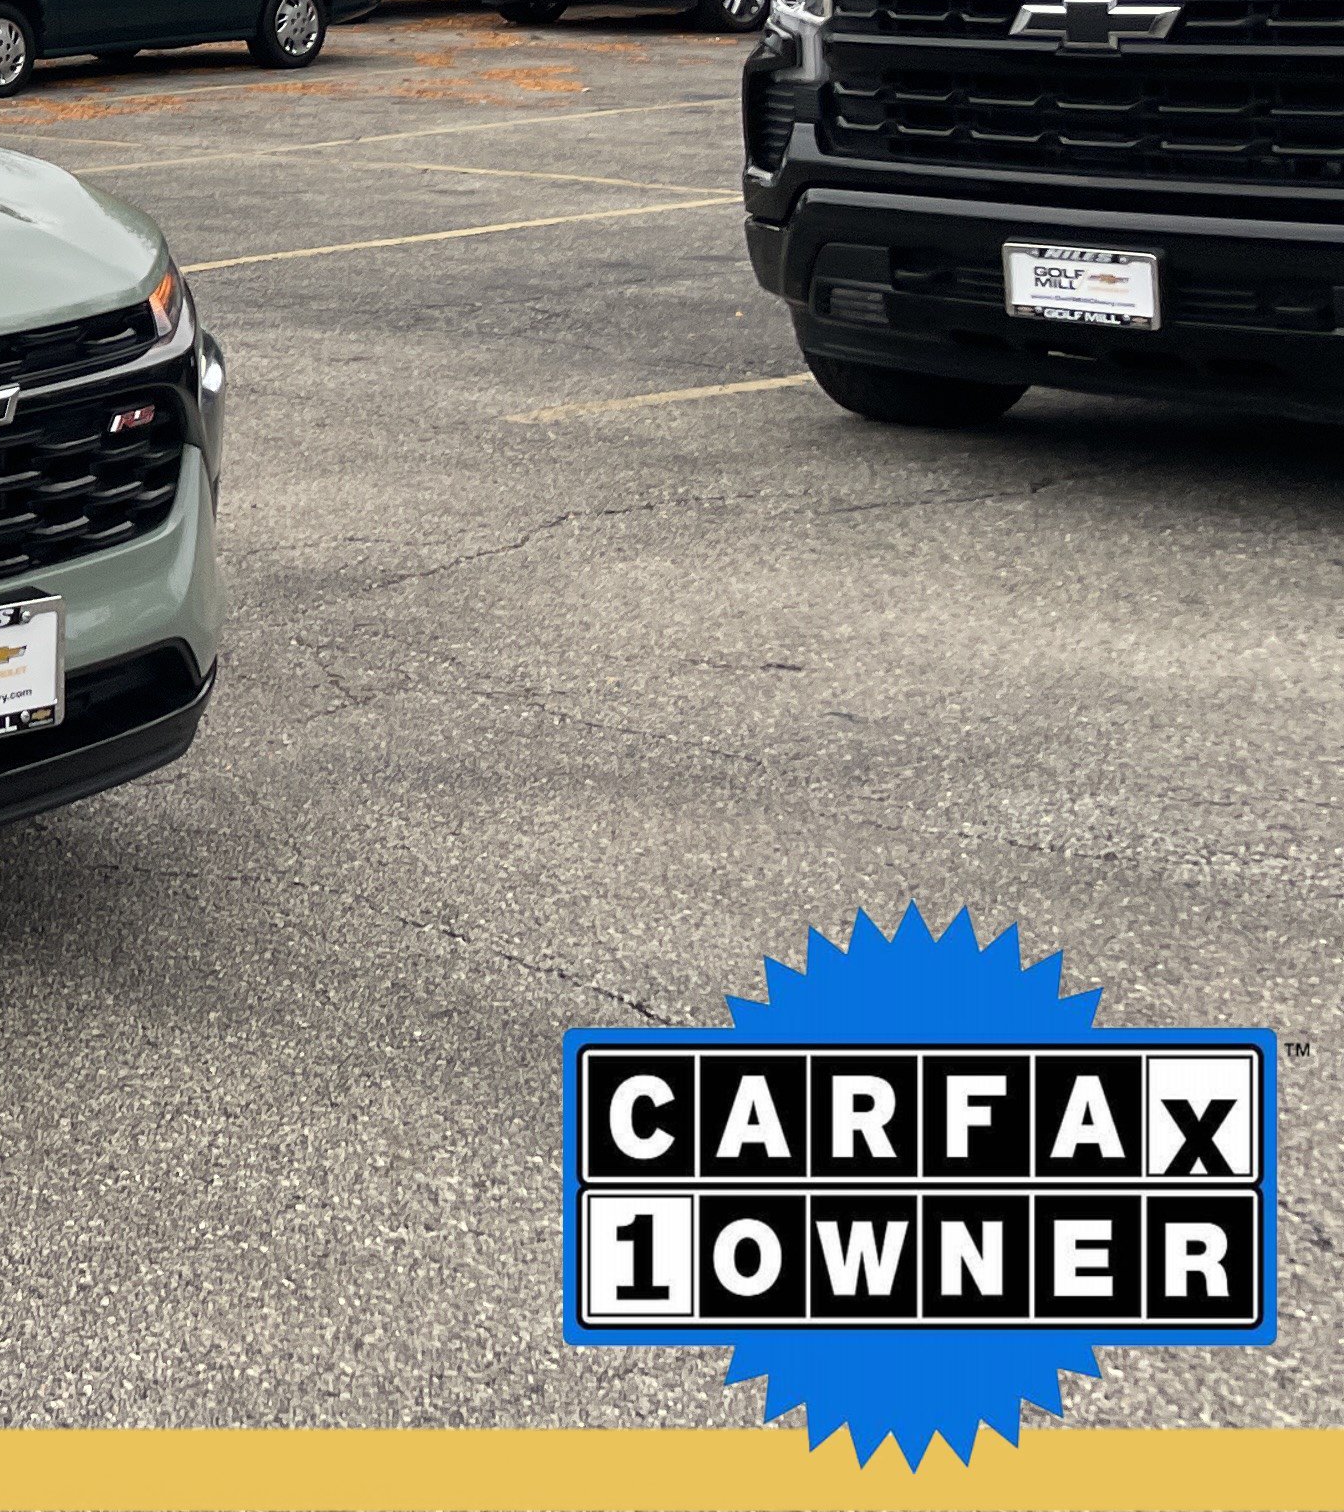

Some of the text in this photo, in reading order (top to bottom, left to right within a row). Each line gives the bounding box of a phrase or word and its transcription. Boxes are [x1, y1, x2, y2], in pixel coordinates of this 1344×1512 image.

[1033, 266, 1085, 280] GOLF
[1033, 277, 1077, 290] MILL
[1043, 308, 1121, 325] GOLF MILL
